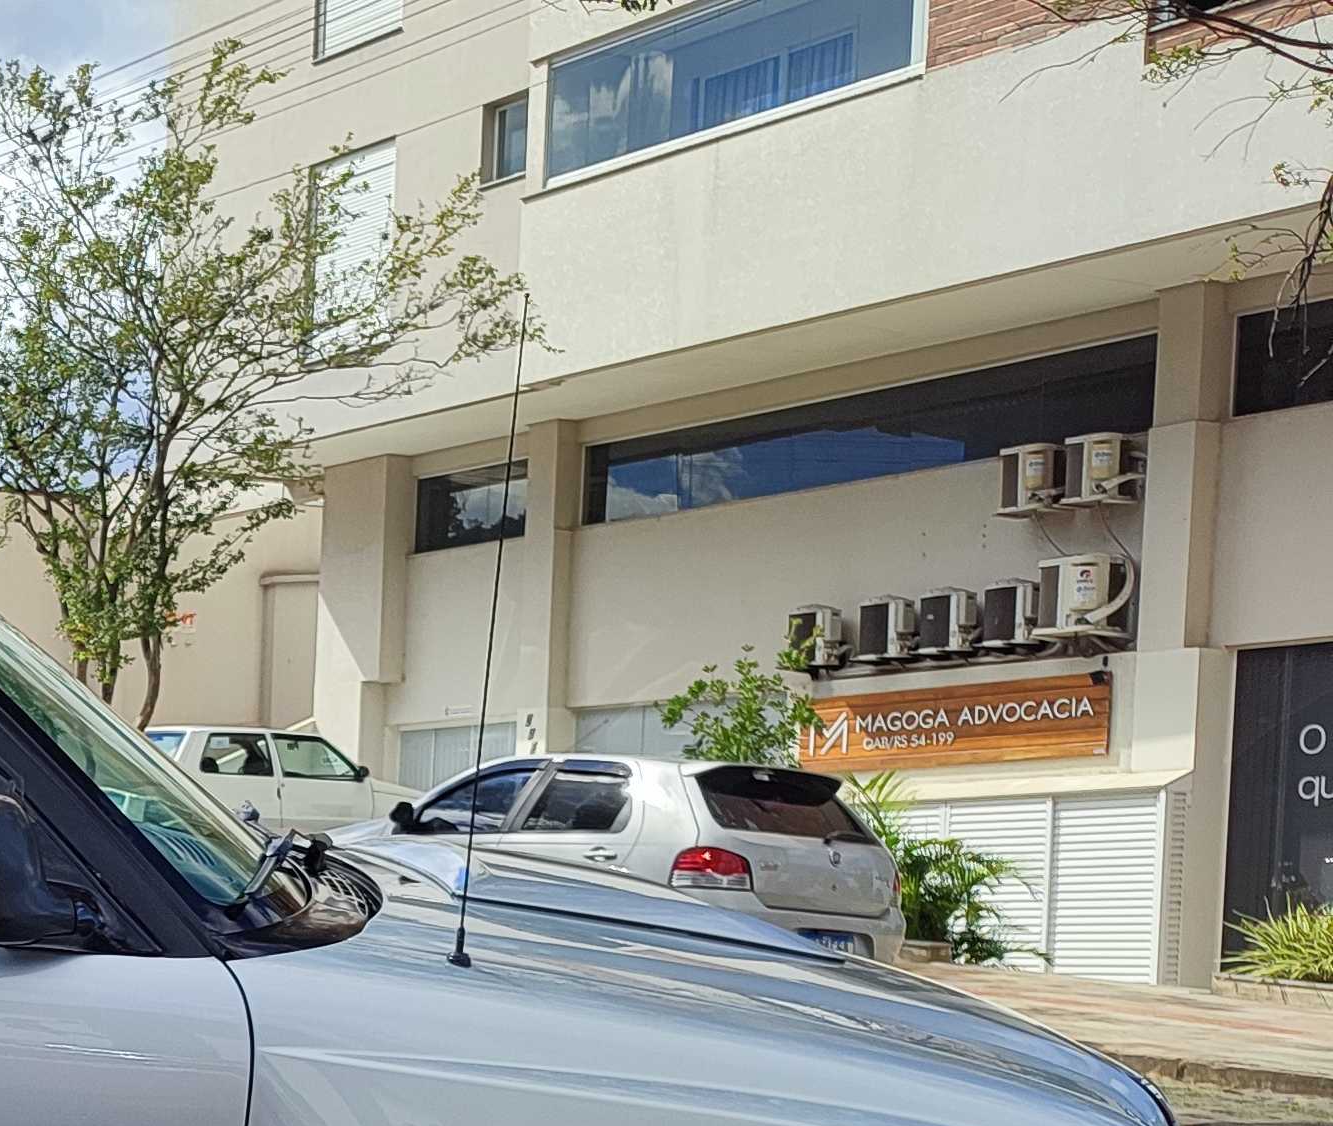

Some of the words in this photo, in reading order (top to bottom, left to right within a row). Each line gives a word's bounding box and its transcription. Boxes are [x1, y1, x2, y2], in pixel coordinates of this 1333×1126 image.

[855, 708, 950, 734] MAGOGA
[957, 696, 1094, 727] ADVOCACIA
[1299, 724, 1327, 755] O
